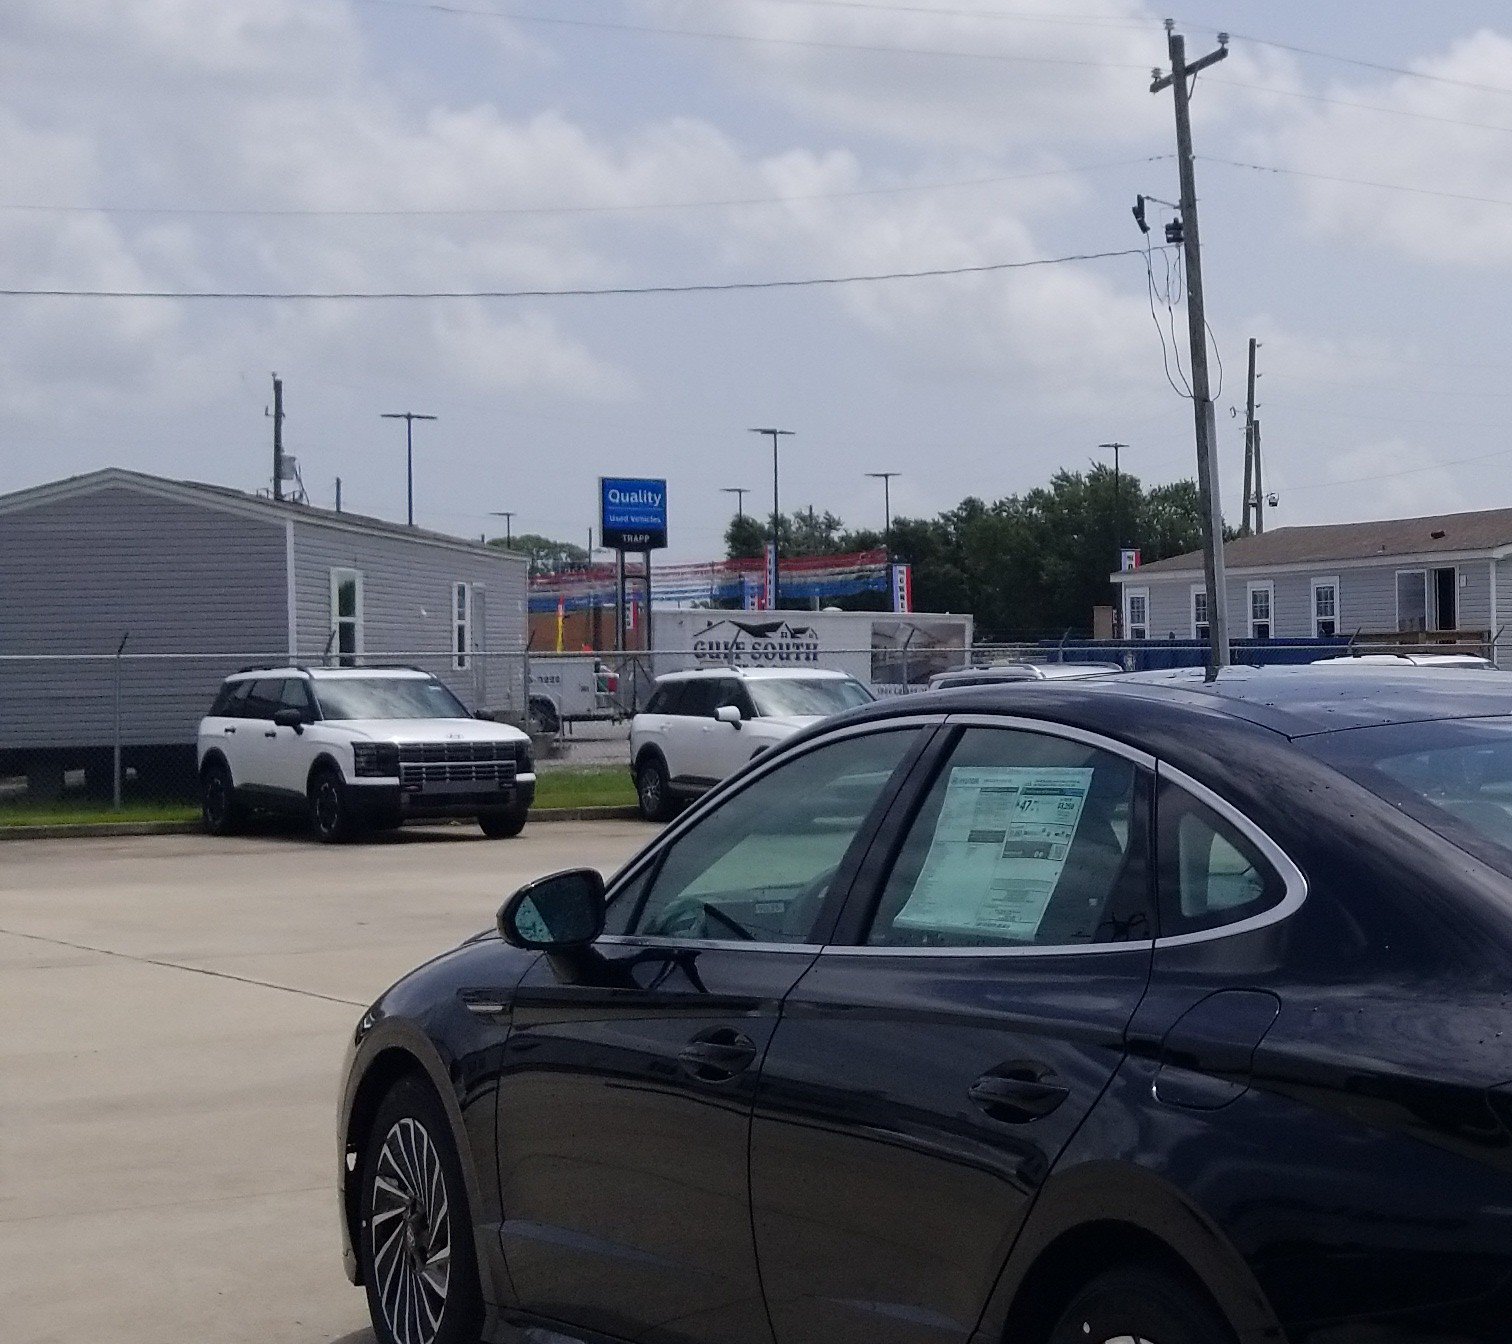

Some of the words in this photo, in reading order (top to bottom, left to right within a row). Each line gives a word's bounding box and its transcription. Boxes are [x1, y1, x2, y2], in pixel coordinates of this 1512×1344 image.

[608, 489, 662, 507] Quality
[609, 514, 629, 523] Used
[622, 534, 650, 543] TRAPP
[751, 642, 819, 661] SOUTH
